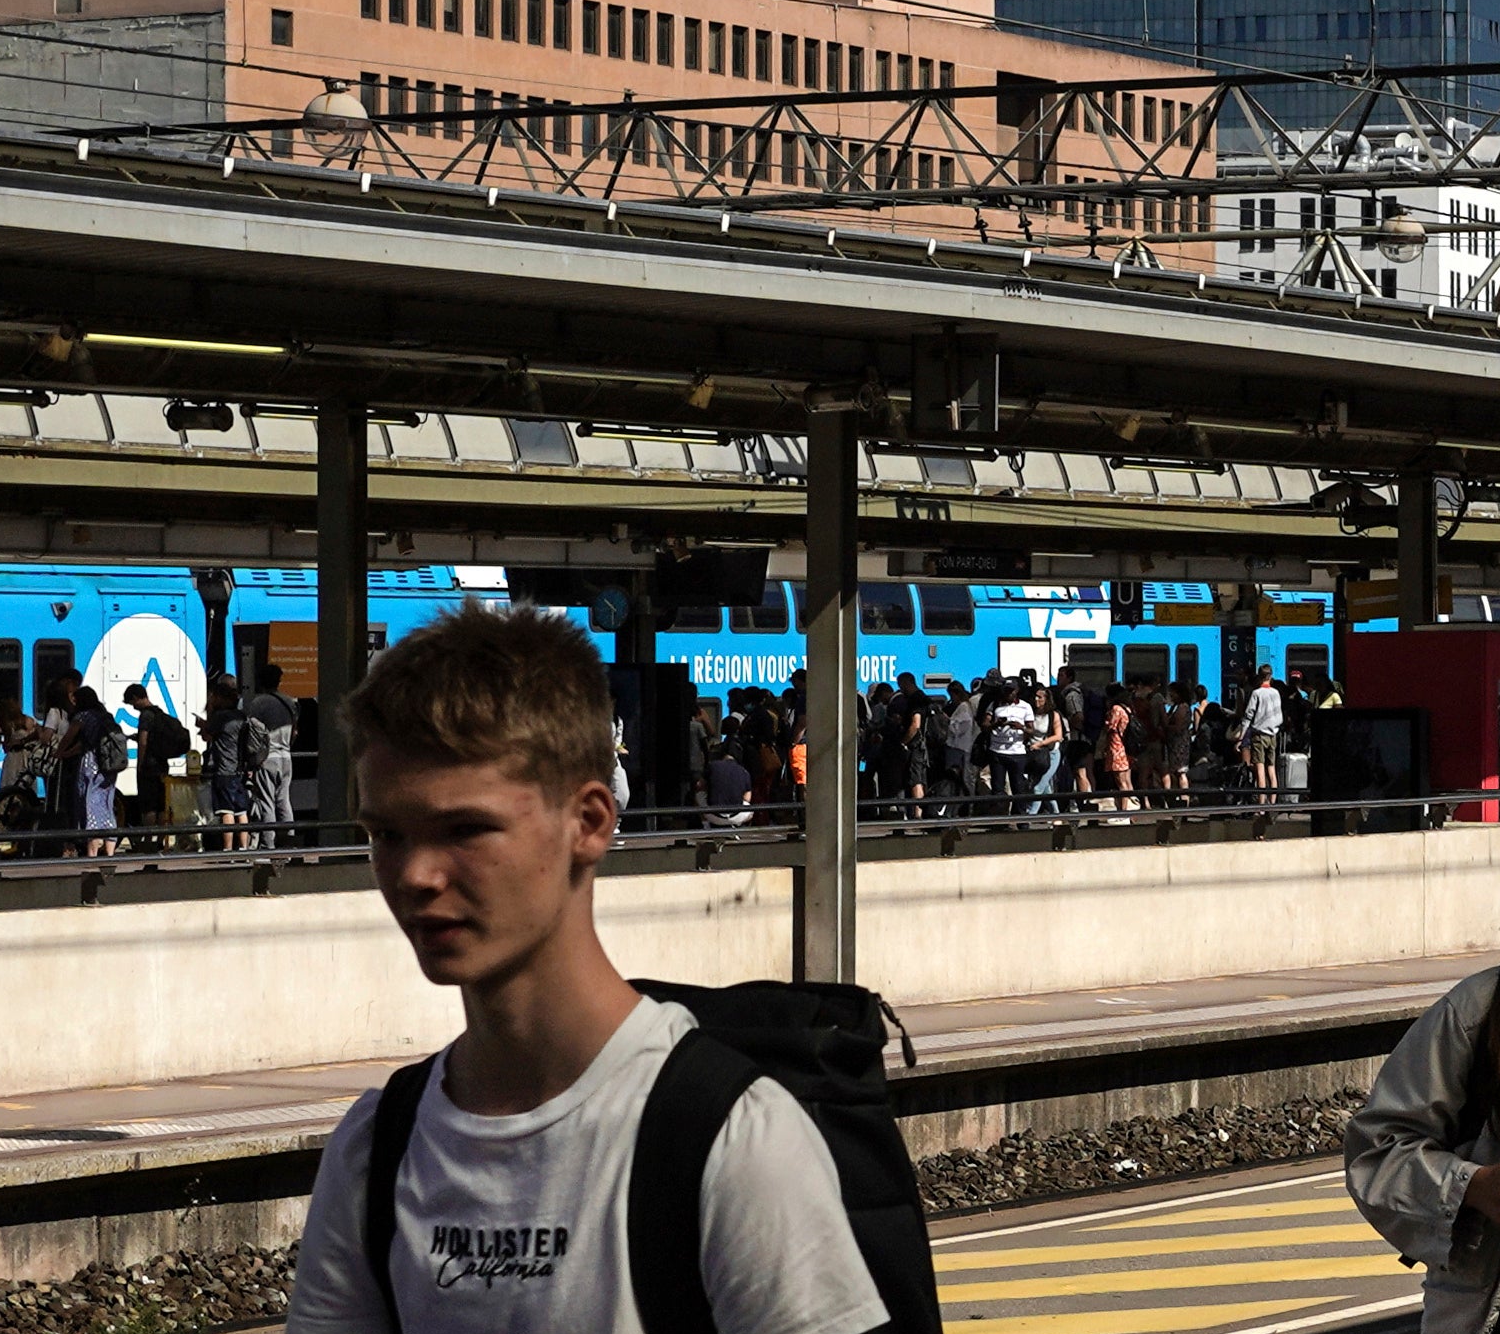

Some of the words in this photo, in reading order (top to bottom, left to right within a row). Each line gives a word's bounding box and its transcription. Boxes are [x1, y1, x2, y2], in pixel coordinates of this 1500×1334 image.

[1118, 581, 1134, 605] U
[1228, 640, 1238, 652] G
[694, 648, 752, 684] RÉGION
[756, 655, 797, 684] VOUS
[430, 1225, 568, 1258] HOLLISTER
[437, 1247, 553, 1289] California
